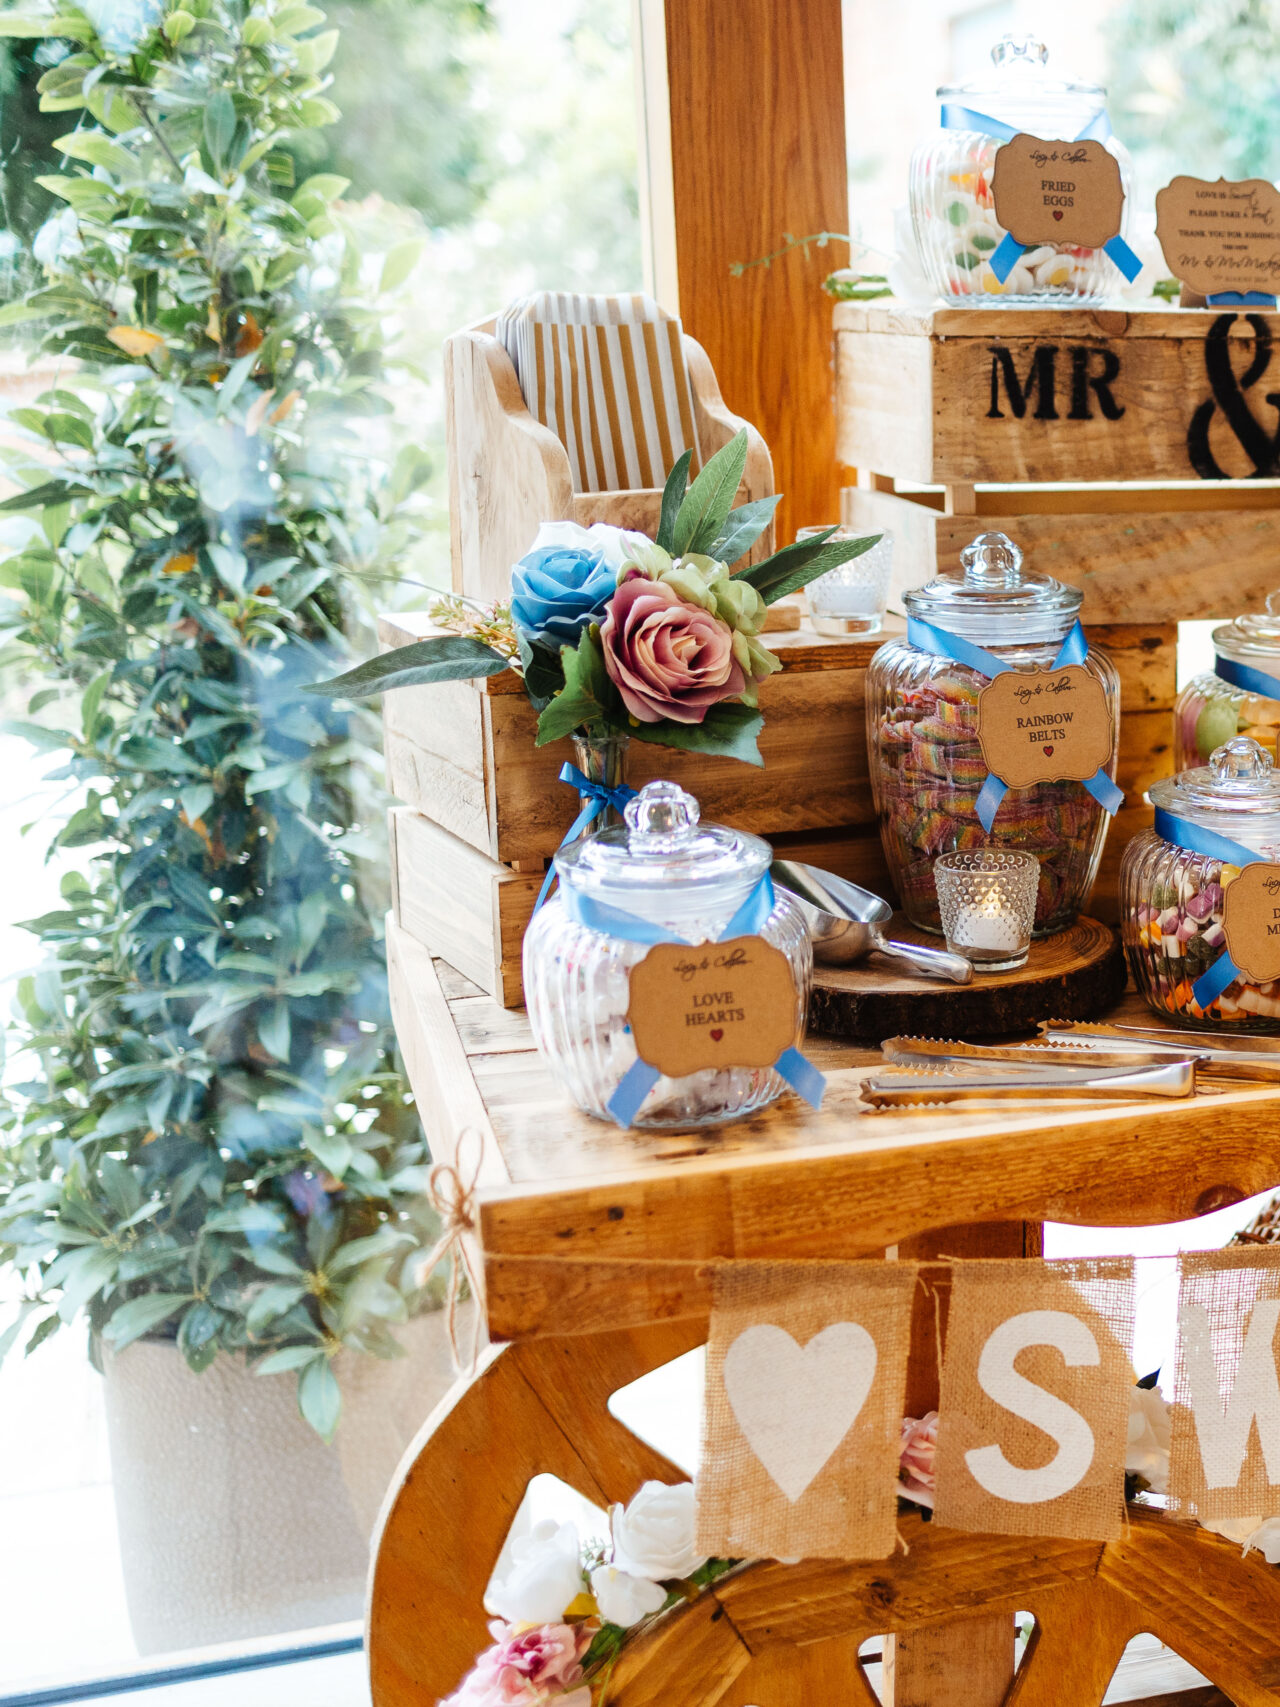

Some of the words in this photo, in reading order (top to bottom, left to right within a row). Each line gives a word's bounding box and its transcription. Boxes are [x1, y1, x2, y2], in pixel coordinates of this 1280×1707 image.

[1041, 180, 1076, 192] FRIED
[1043, 195, 1074, 207] EGGS
[1178, 229, 1206, 238] THANK
[986, 346, 1126, 421] MR
[1017, 712, 1074, 728] RAINBOW
[1029, 729, 1066, 742] BELTS
[692, 992, 734, 1008] LOVE
[685, 1008, 745, 1026] HEARTS
